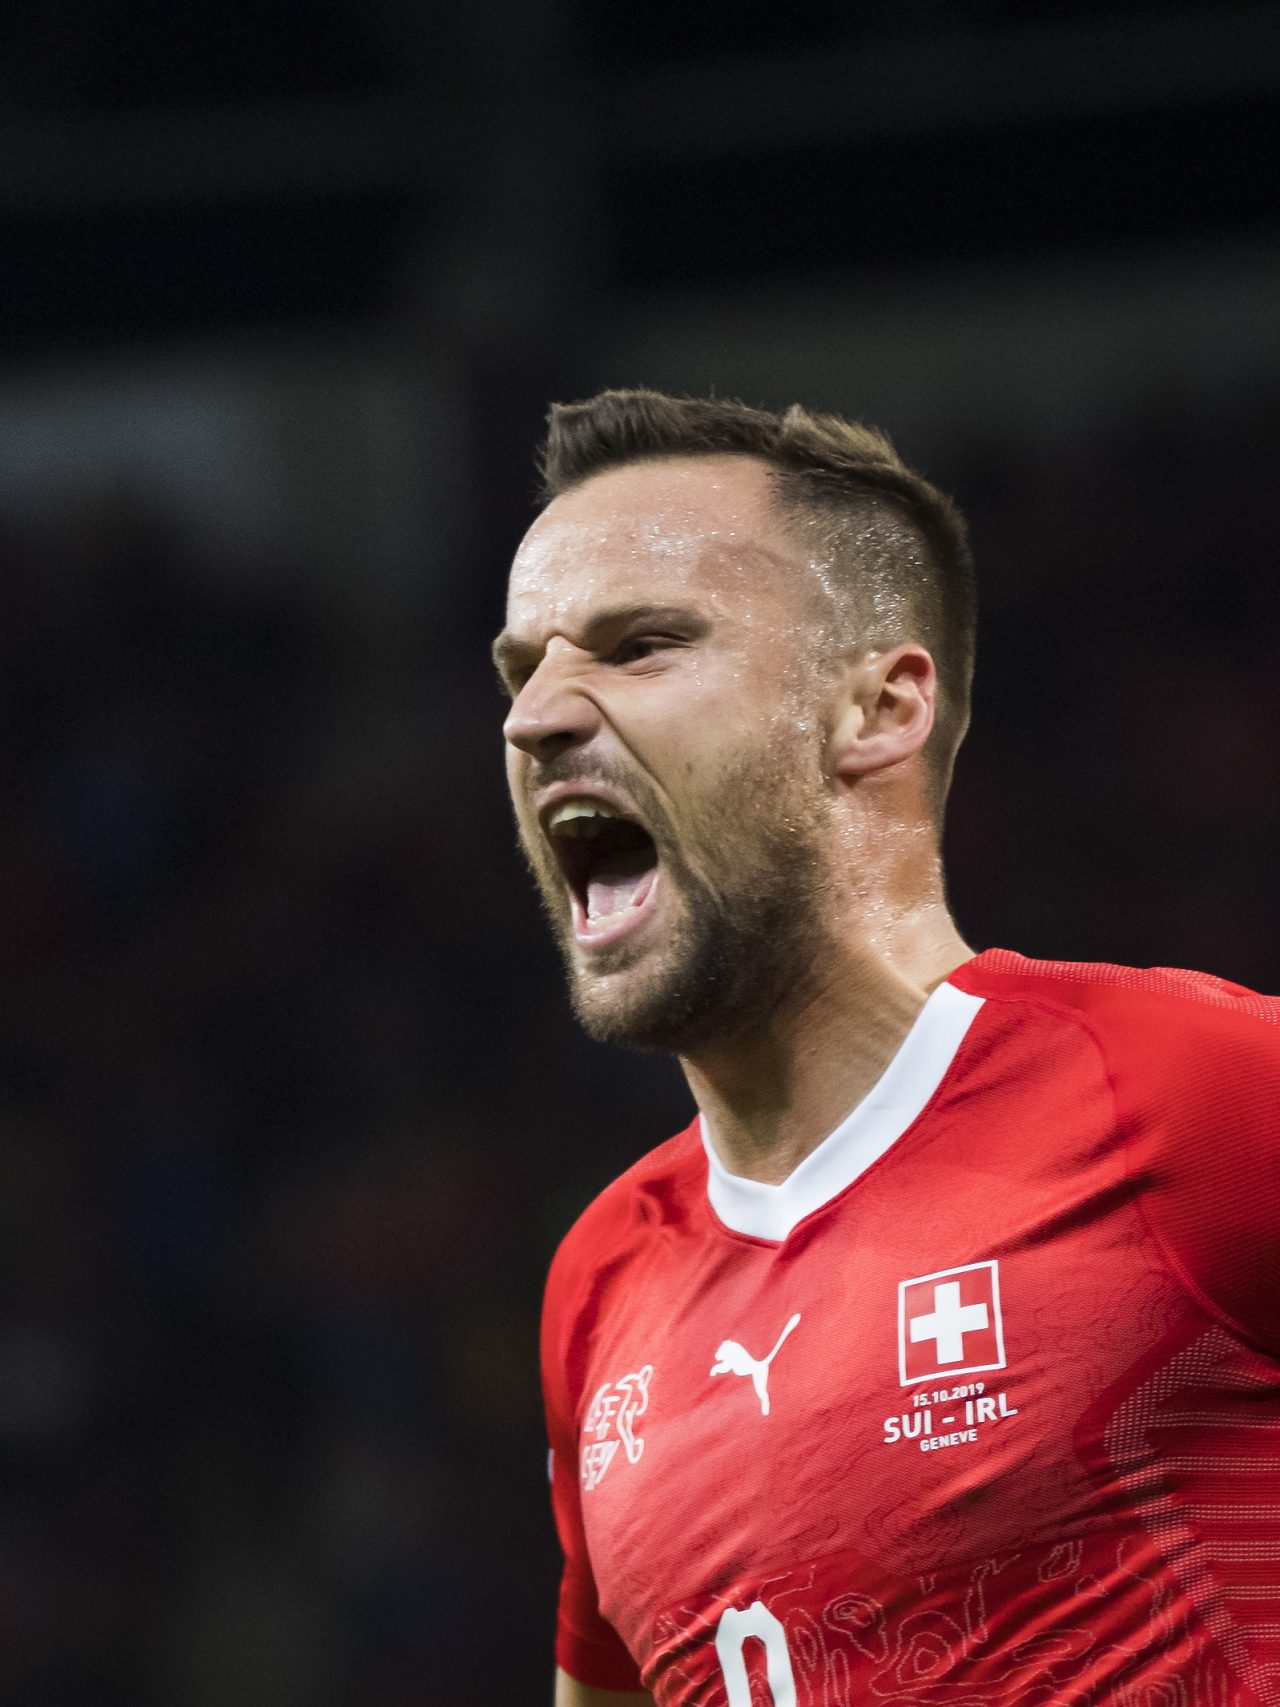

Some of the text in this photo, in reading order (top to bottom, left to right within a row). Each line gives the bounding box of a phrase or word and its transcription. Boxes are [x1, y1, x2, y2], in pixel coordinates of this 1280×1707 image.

[913, 1383, 985, 1407] 15.10.2019
[883, 1393, 1019, 1443] SUI - IRL
[920, 1429, 978, 1452] GENEVE
